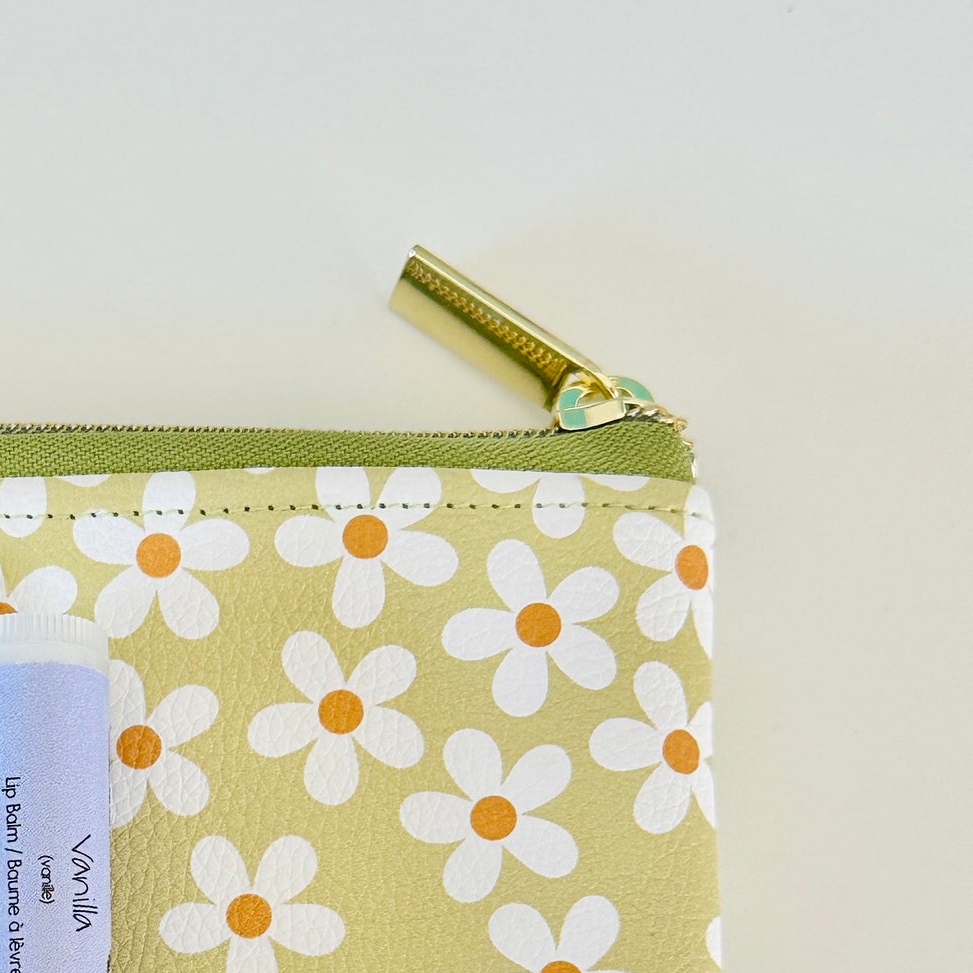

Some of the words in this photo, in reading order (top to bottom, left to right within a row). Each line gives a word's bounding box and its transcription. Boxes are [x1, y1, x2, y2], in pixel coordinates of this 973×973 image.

[2, 777, 21, 799] Lip
[5, 805, 21, 843] Balm
[7, 859, 22, 916] Baume
[71, 834, 98, 932] Vanilla
[8, 921, 24, 932] à
